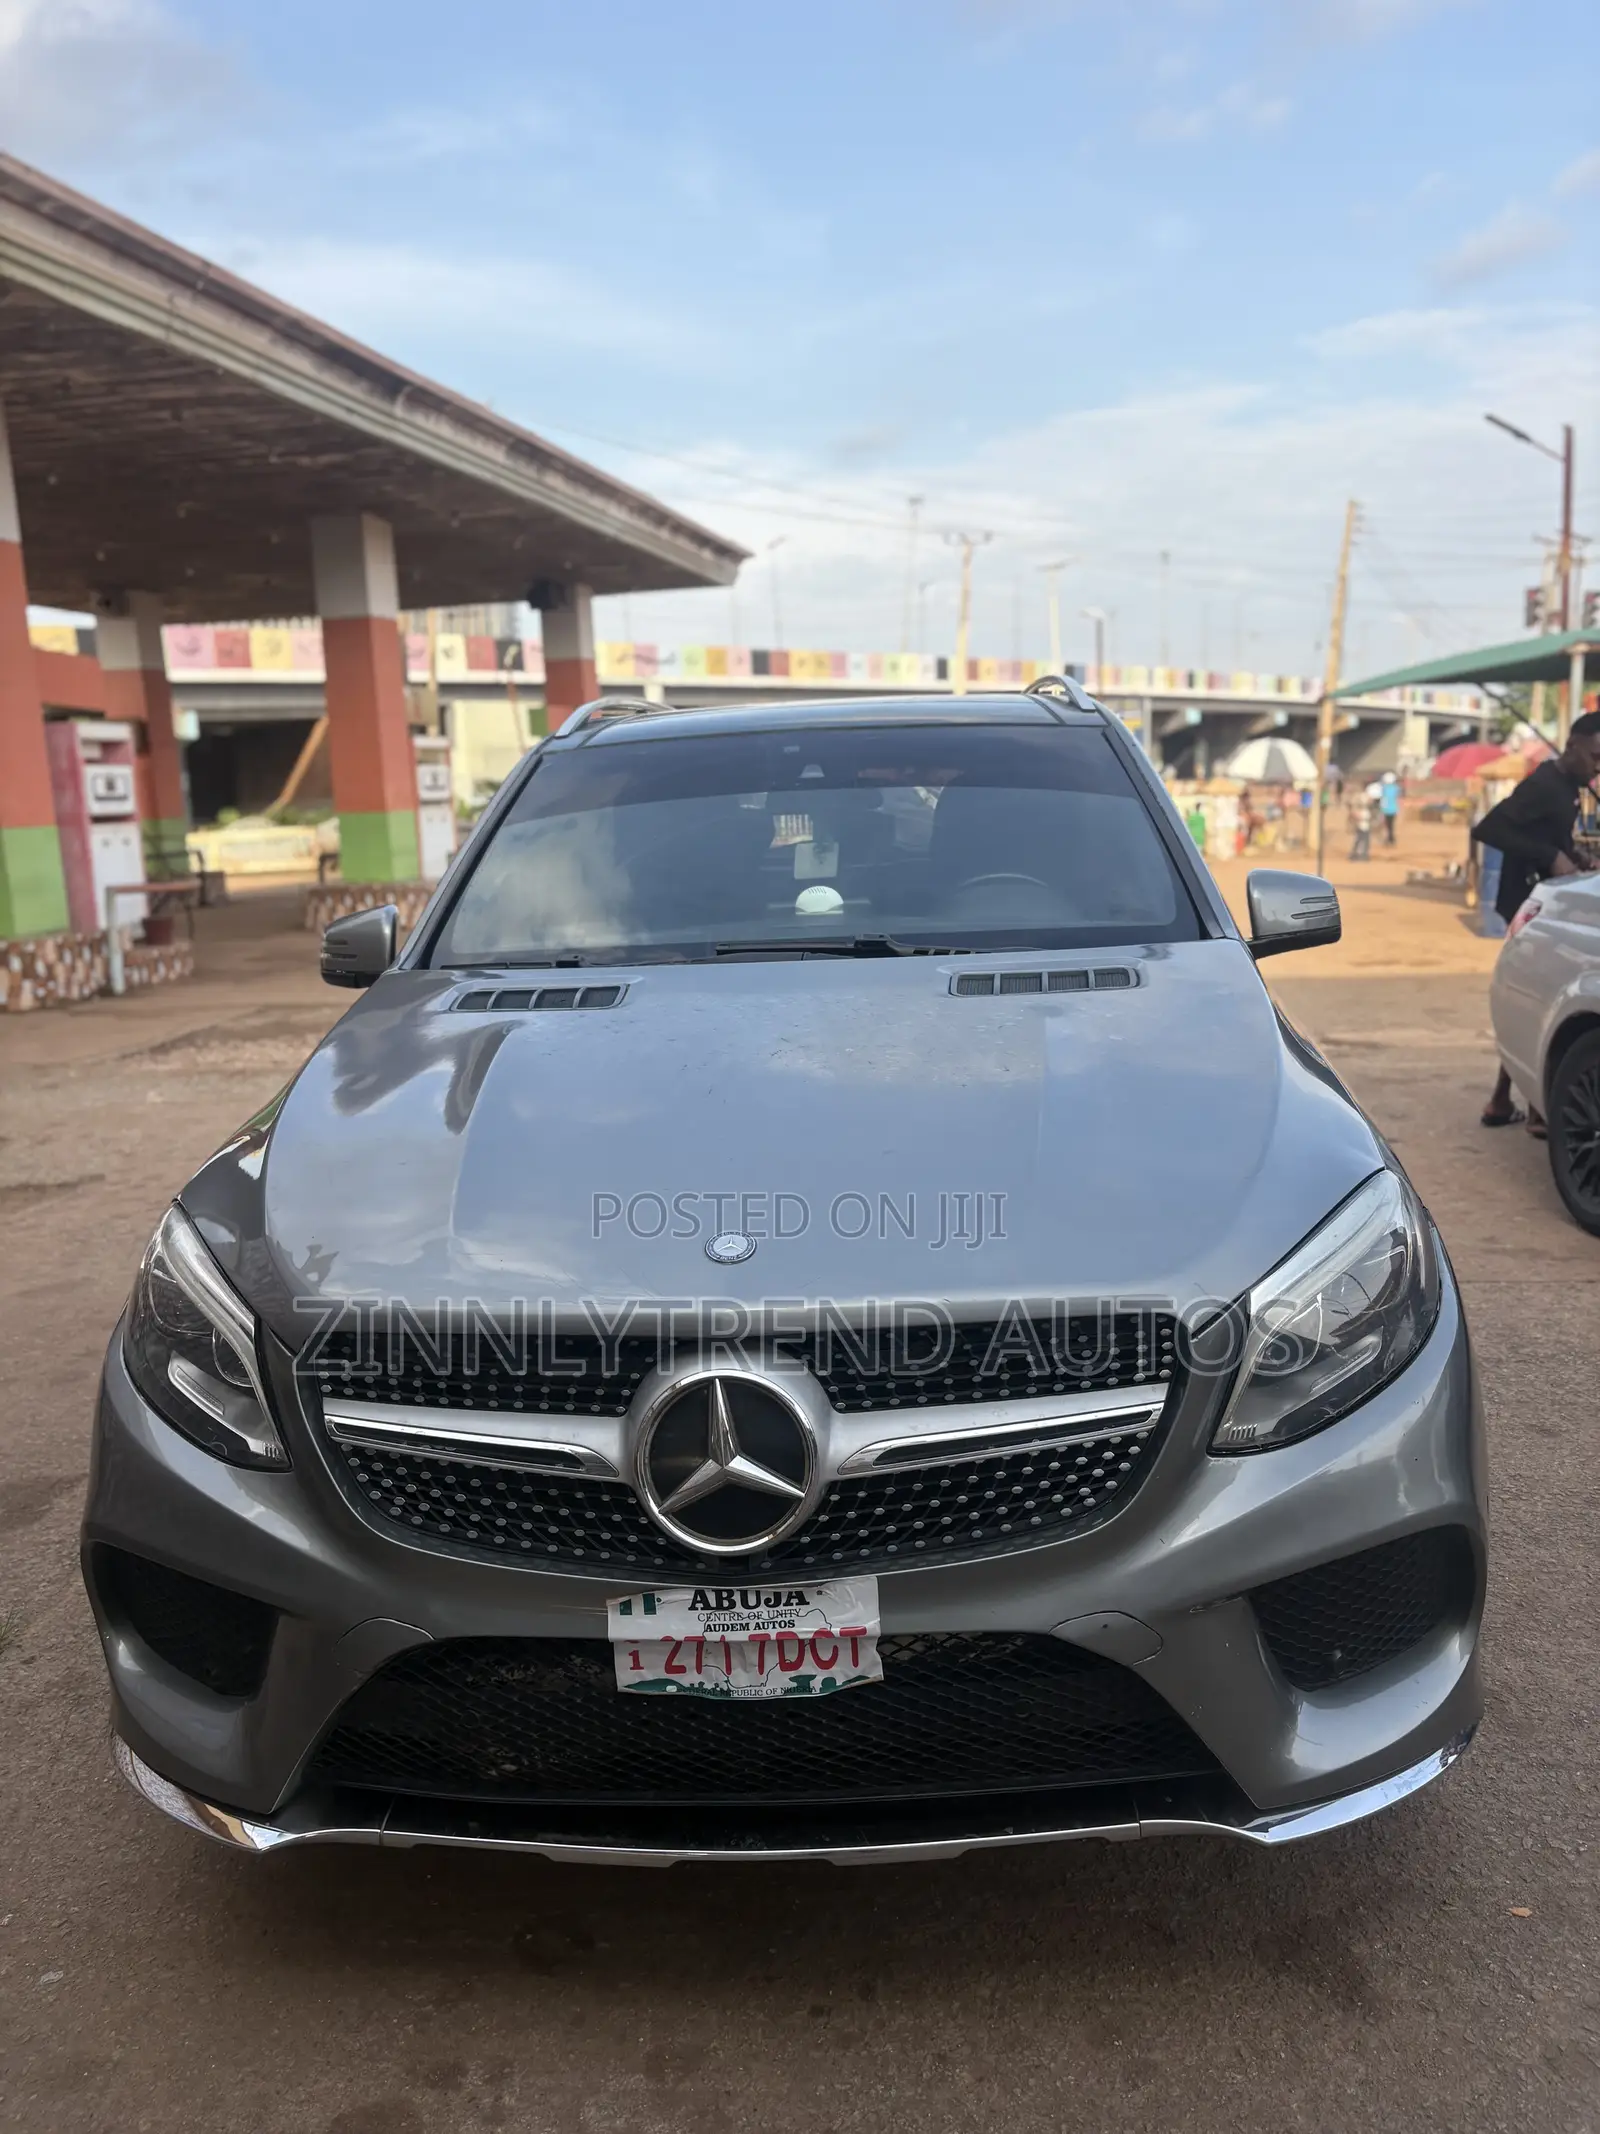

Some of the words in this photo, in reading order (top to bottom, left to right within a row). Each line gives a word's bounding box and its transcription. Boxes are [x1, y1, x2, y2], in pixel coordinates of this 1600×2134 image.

[688, 1588, 810, 1610] ABUJA
[697, 1611, 744, 1622] CENTRE
[747, 1611, 764, 1621] OF
[767, 1608, 802, 1619] UNITY
[704, 1622, 750, 1633] AUDEM
[753, 1619, 796, 1631] AUTOS
[765, 1687, 778, 1696] OF
